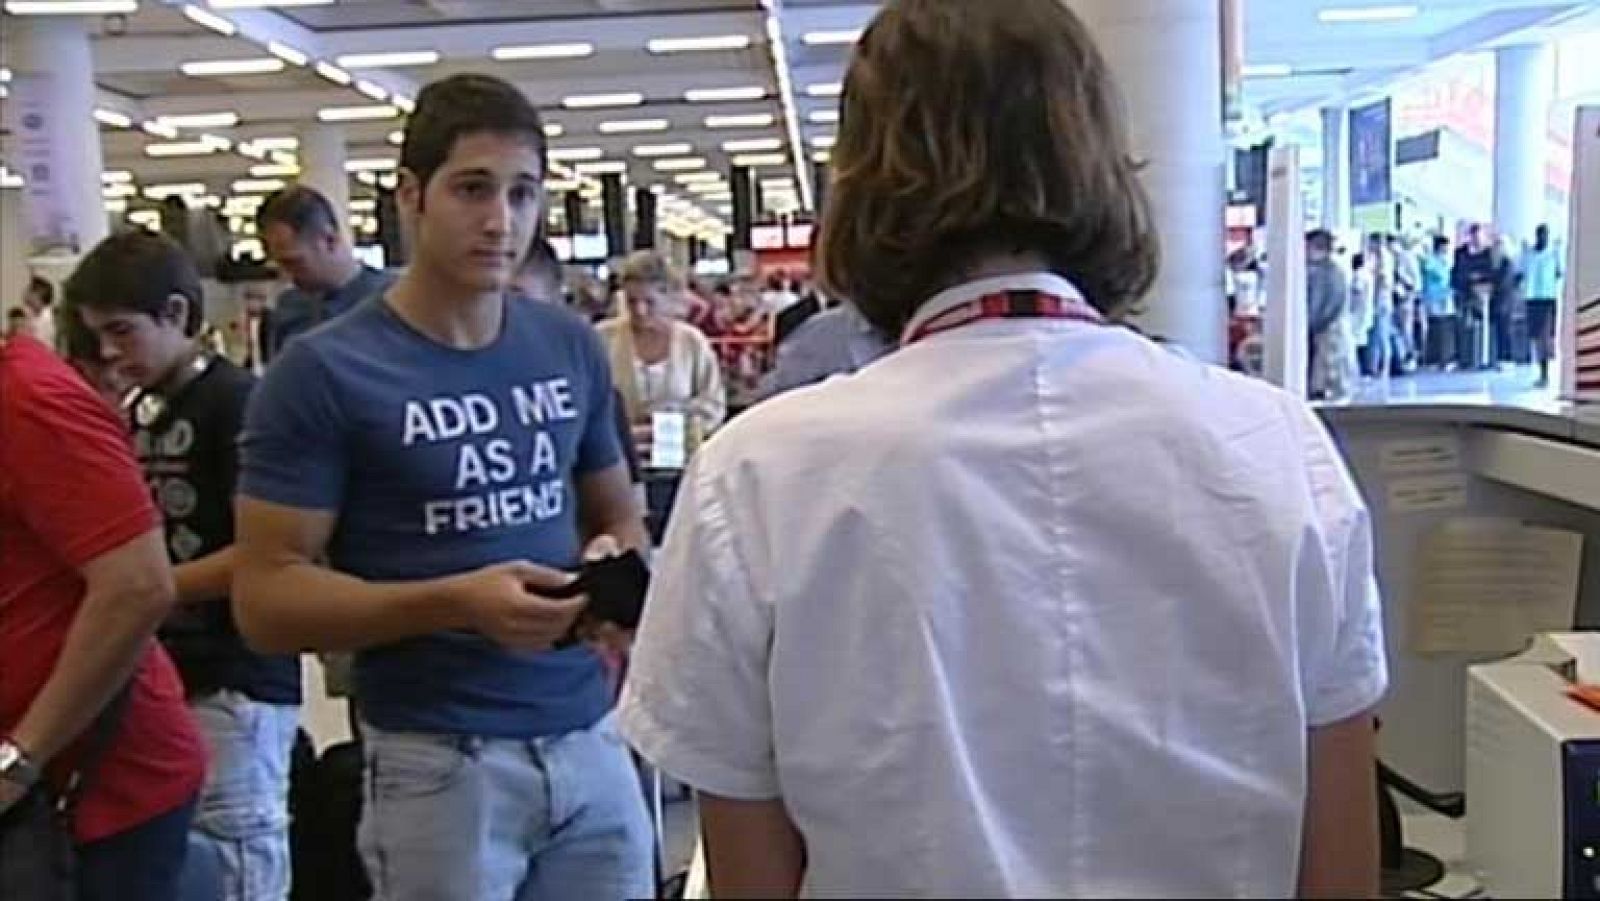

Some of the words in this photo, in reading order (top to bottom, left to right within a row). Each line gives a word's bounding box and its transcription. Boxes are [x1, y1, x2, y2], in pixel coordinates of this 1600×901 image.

[404, 394, 498, 444] ADD
[511, 378, 578, 424] ME
[456, 439, 515, 488] AS
[530, 431, 557, 475] A
[424, 479, 563, 535] FRIEND
